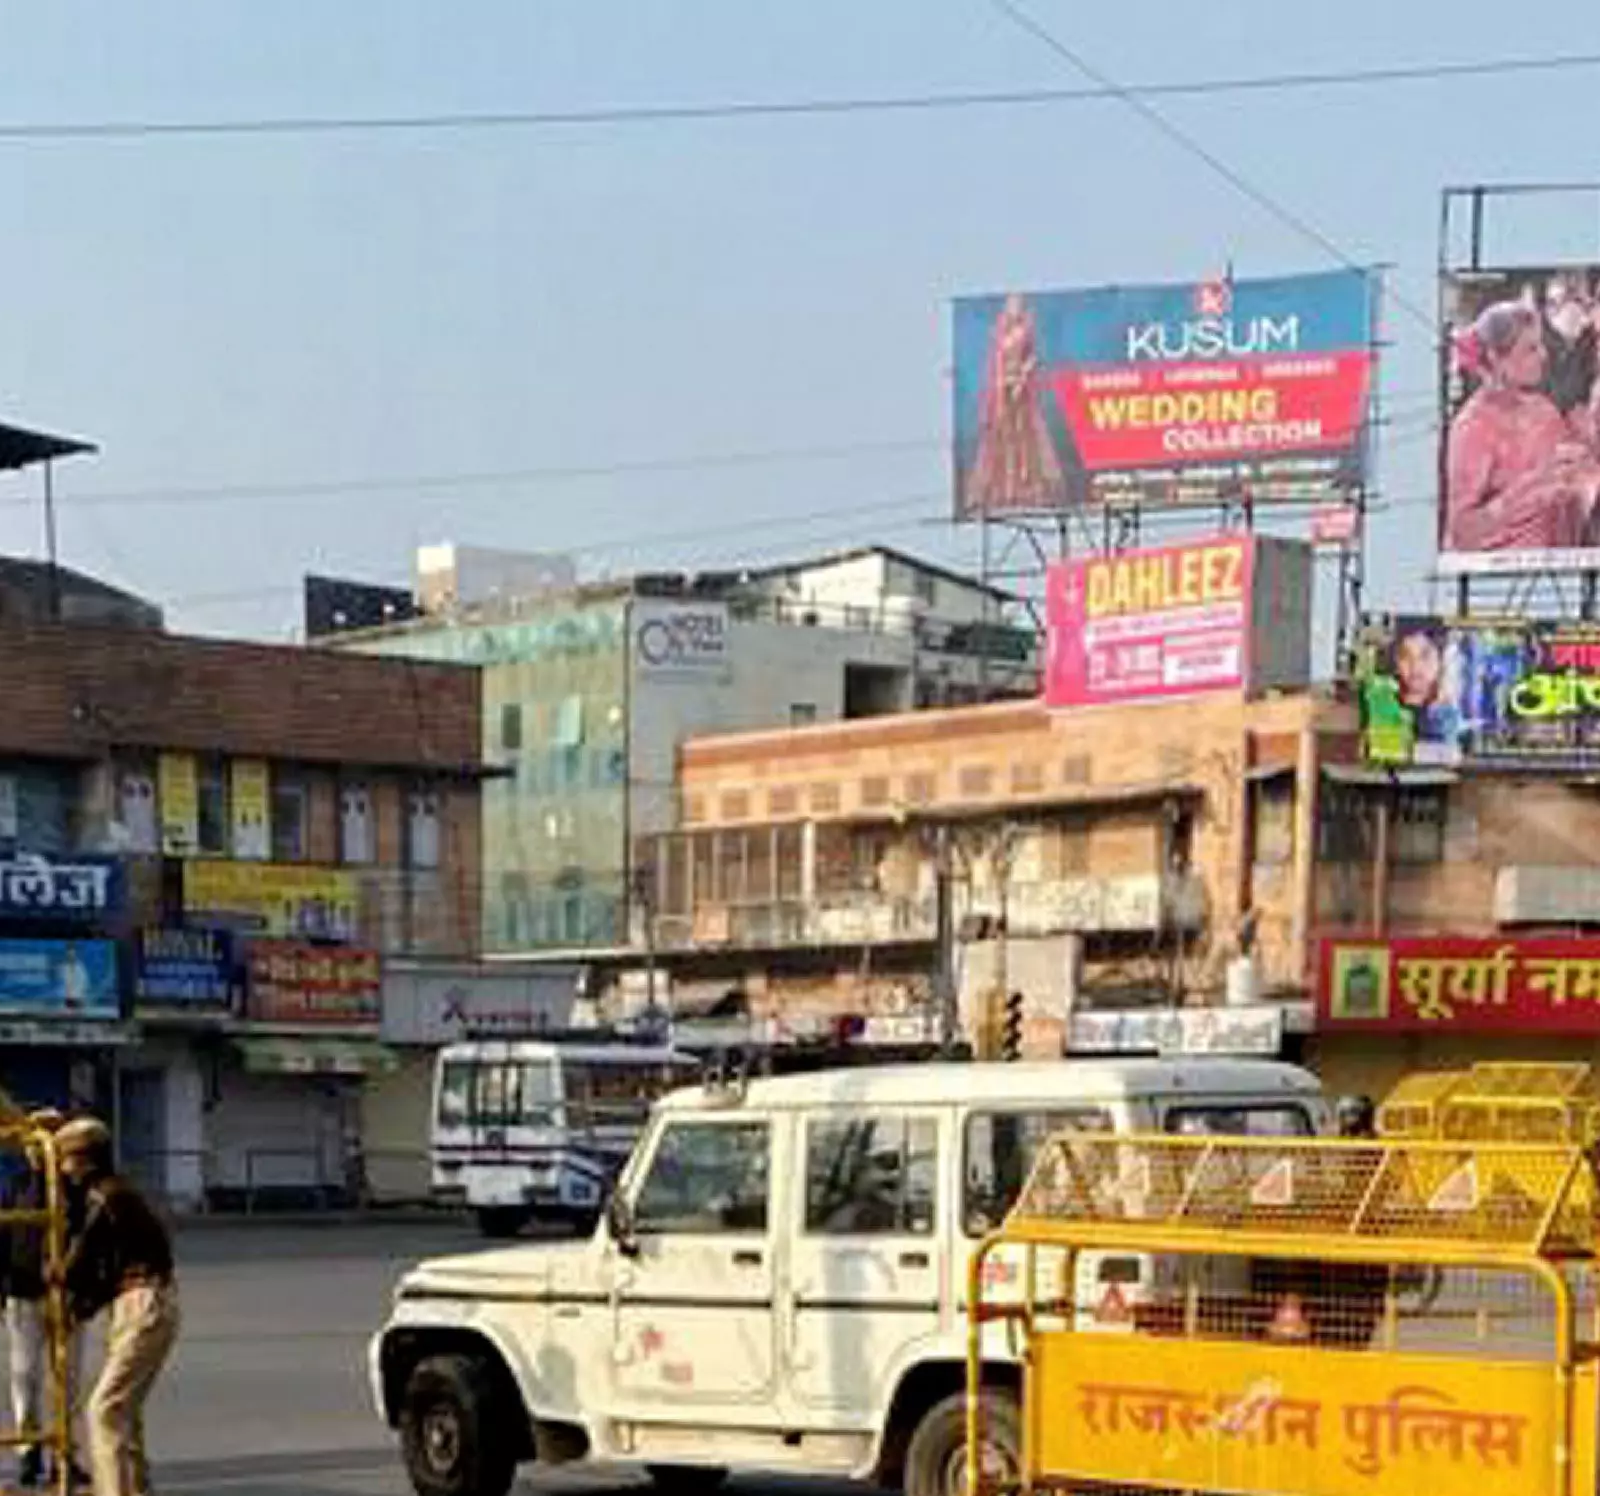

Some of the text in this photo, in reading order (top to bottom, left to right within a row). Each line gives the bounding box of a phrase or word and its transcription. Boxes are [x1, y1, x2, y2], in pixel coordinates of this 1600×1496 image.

[1127, 316, 1298, 360] KUSUM
[1087, 388, 1277, 430] WEDDING
[1162, 418, 1321, 452] COLLECTION
[1086, 546, 1243, 616] DAHLEEZ
[1398, 944, 1517, 1018] सूर्या
[1342, 1385, 1527, 1475] पुलिस
